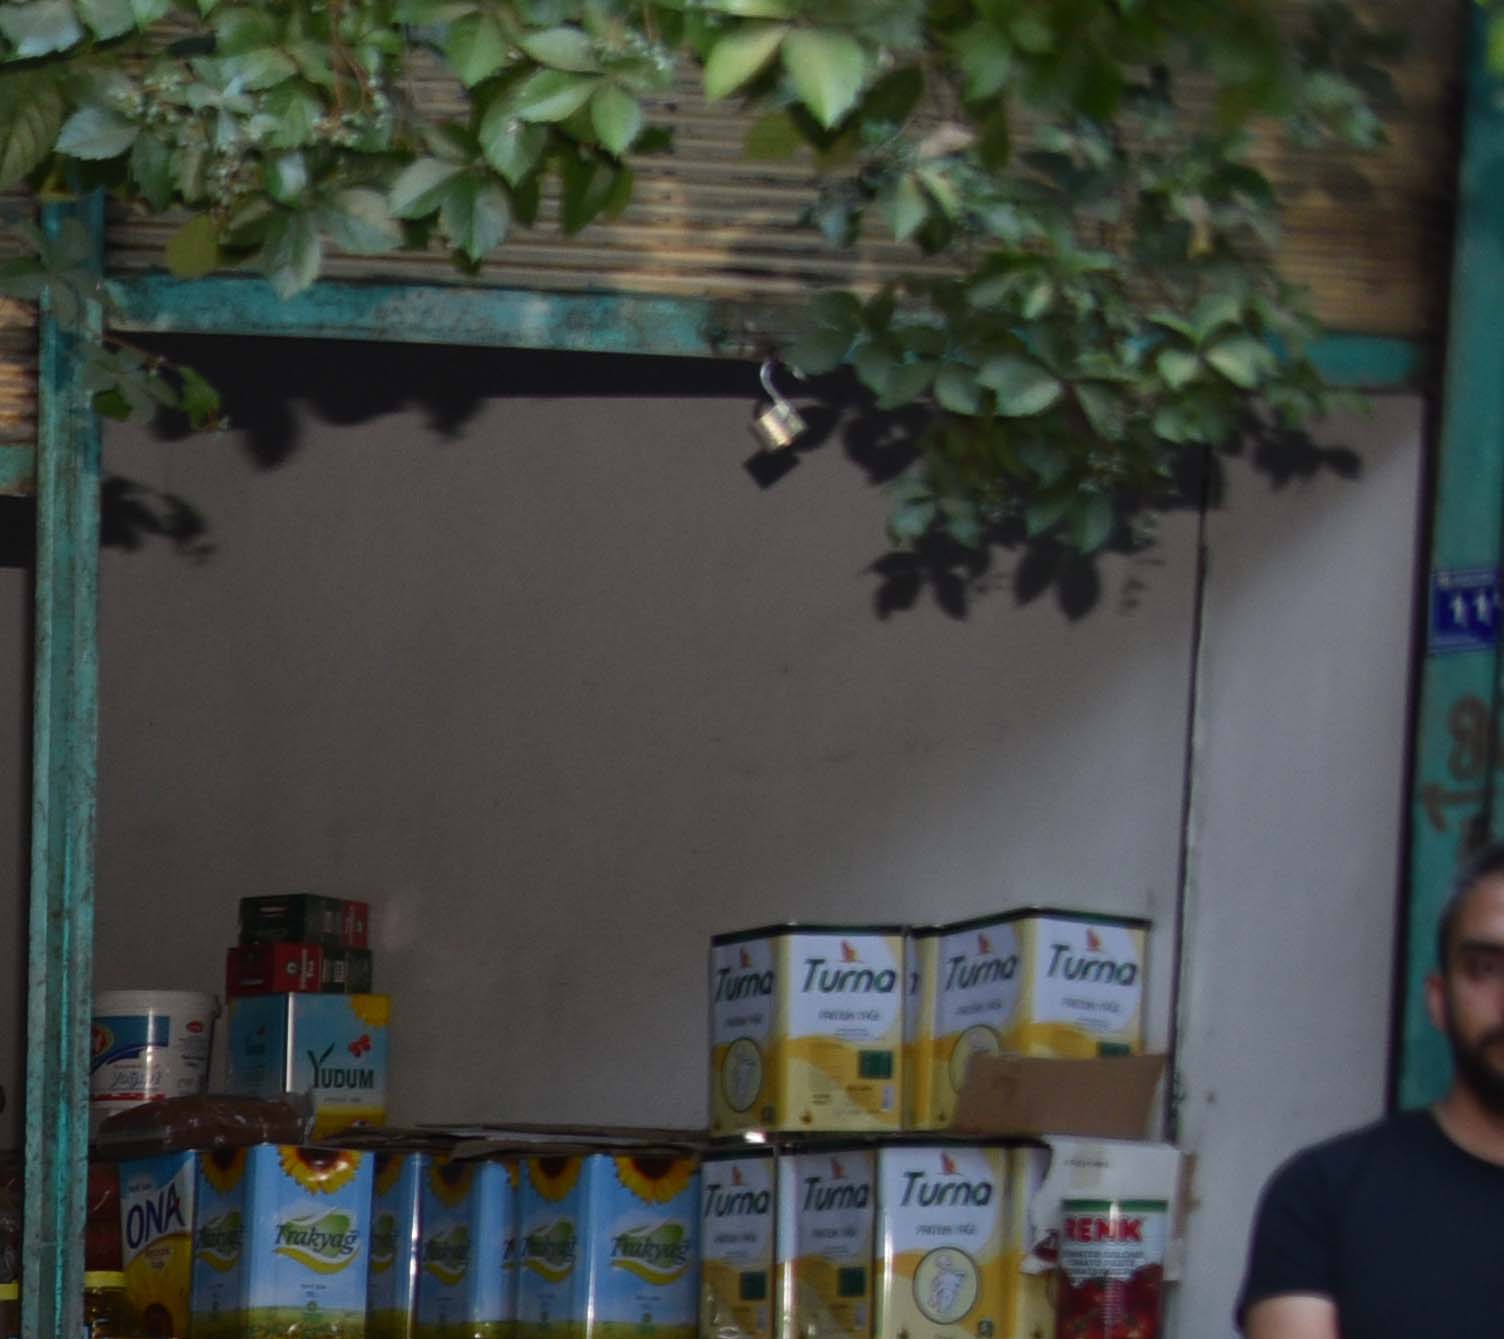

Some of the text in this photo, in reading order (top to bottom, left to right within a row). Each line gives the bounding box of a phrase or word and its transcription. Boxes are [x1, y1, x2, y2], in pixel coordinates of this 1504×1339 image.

[801, 957, 897, 994] Turna
[945, 954, 1019, 992] Turna
[1047, 943, 1138, 986] Turna
[715, 967, 774, 1003] Turna
[307, 1042, 374, 1089] YUDUM
[704, 1183, 771, 1218] Turna
[802, 1176, 869, 1213] Turna
[899, 1171, 993, 1207] Turna
[126, 1182, 185, 1250] ONA
